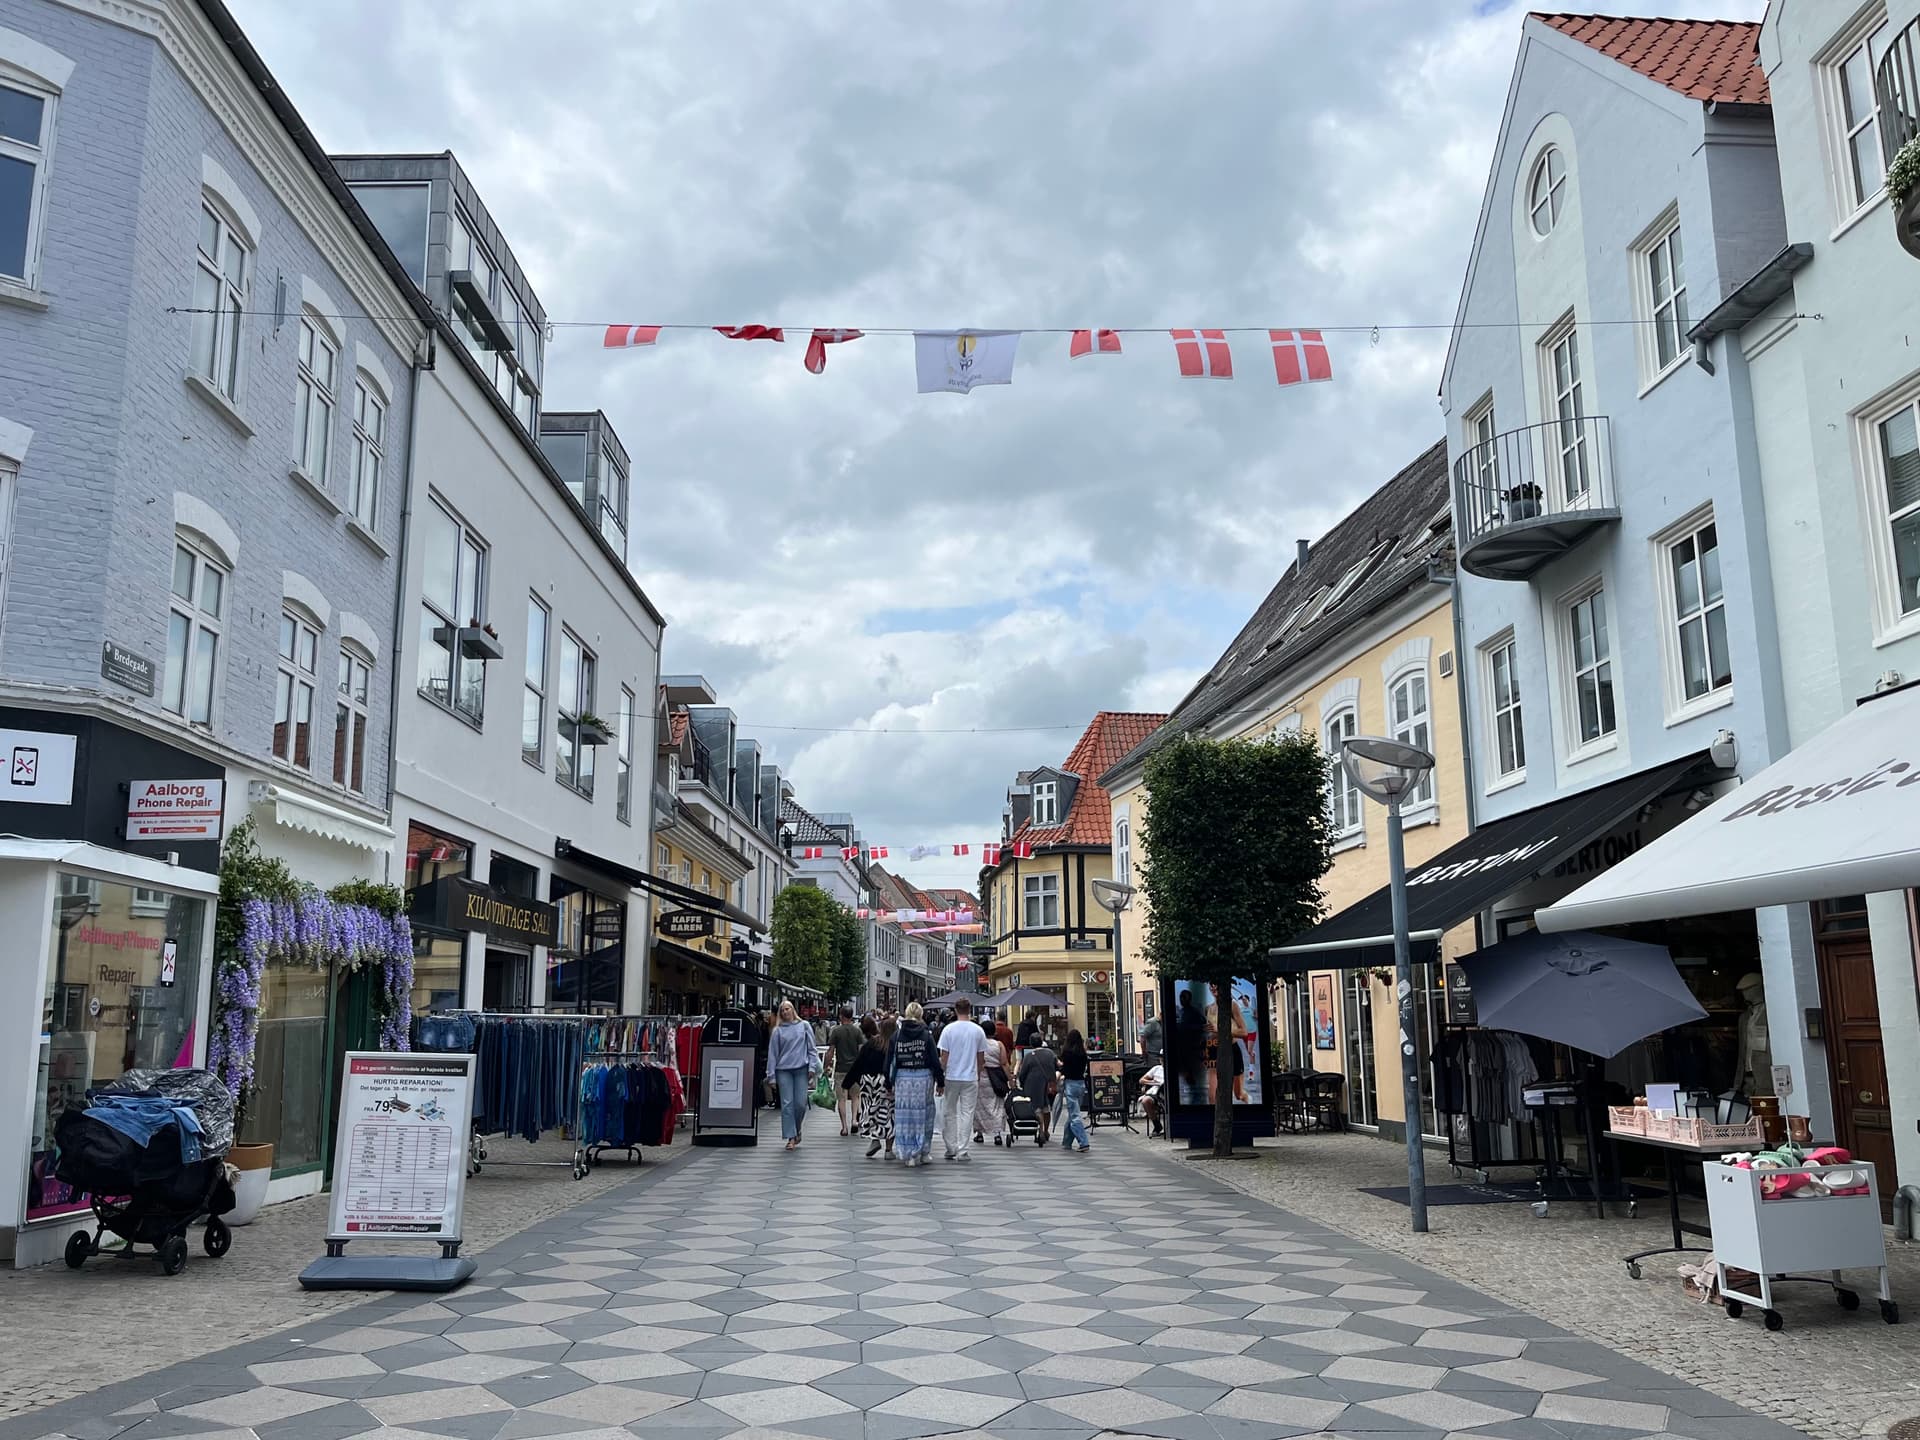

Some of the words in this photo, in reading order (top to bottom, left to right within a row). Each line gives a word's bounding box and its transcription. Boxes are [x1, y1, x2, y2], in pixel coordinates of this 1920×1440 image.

[145, 783, 205, 798] Aalborg
[137, 798, 173, 808] Phone
[175, 797, 213, 808] Repair
[1405, 835, 1559, 887] BERTONI
[465, 893, 531, 931] KILOVINTAGE
[672, 915, 702, 924] KAFFE
[670, 924, 703, 932] BAREN
[127, 931, 160, 951] Phone
[100, 964, 136, 985] Repair
